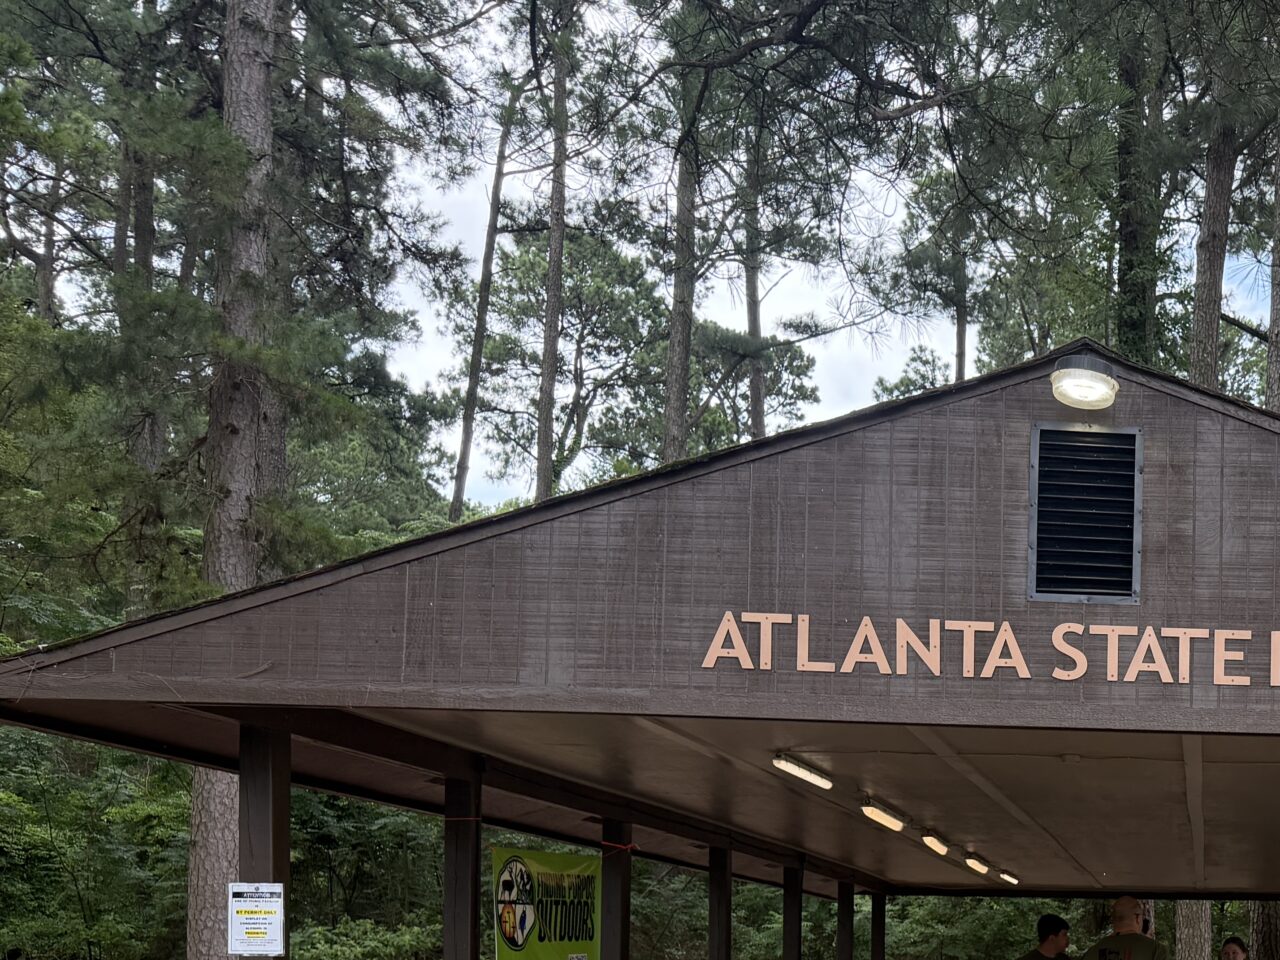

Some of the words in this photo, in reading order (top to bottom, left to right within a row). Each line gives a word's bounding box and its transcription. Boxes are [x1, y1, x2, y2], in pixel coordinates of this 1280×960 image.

[702, 610, 1031, 680] ATLANTA
[1051, 622, 1253, 686] STATE
[537, 871, 564, 899] FINDING
[536, 898, 596, 942] OUTDOORS
